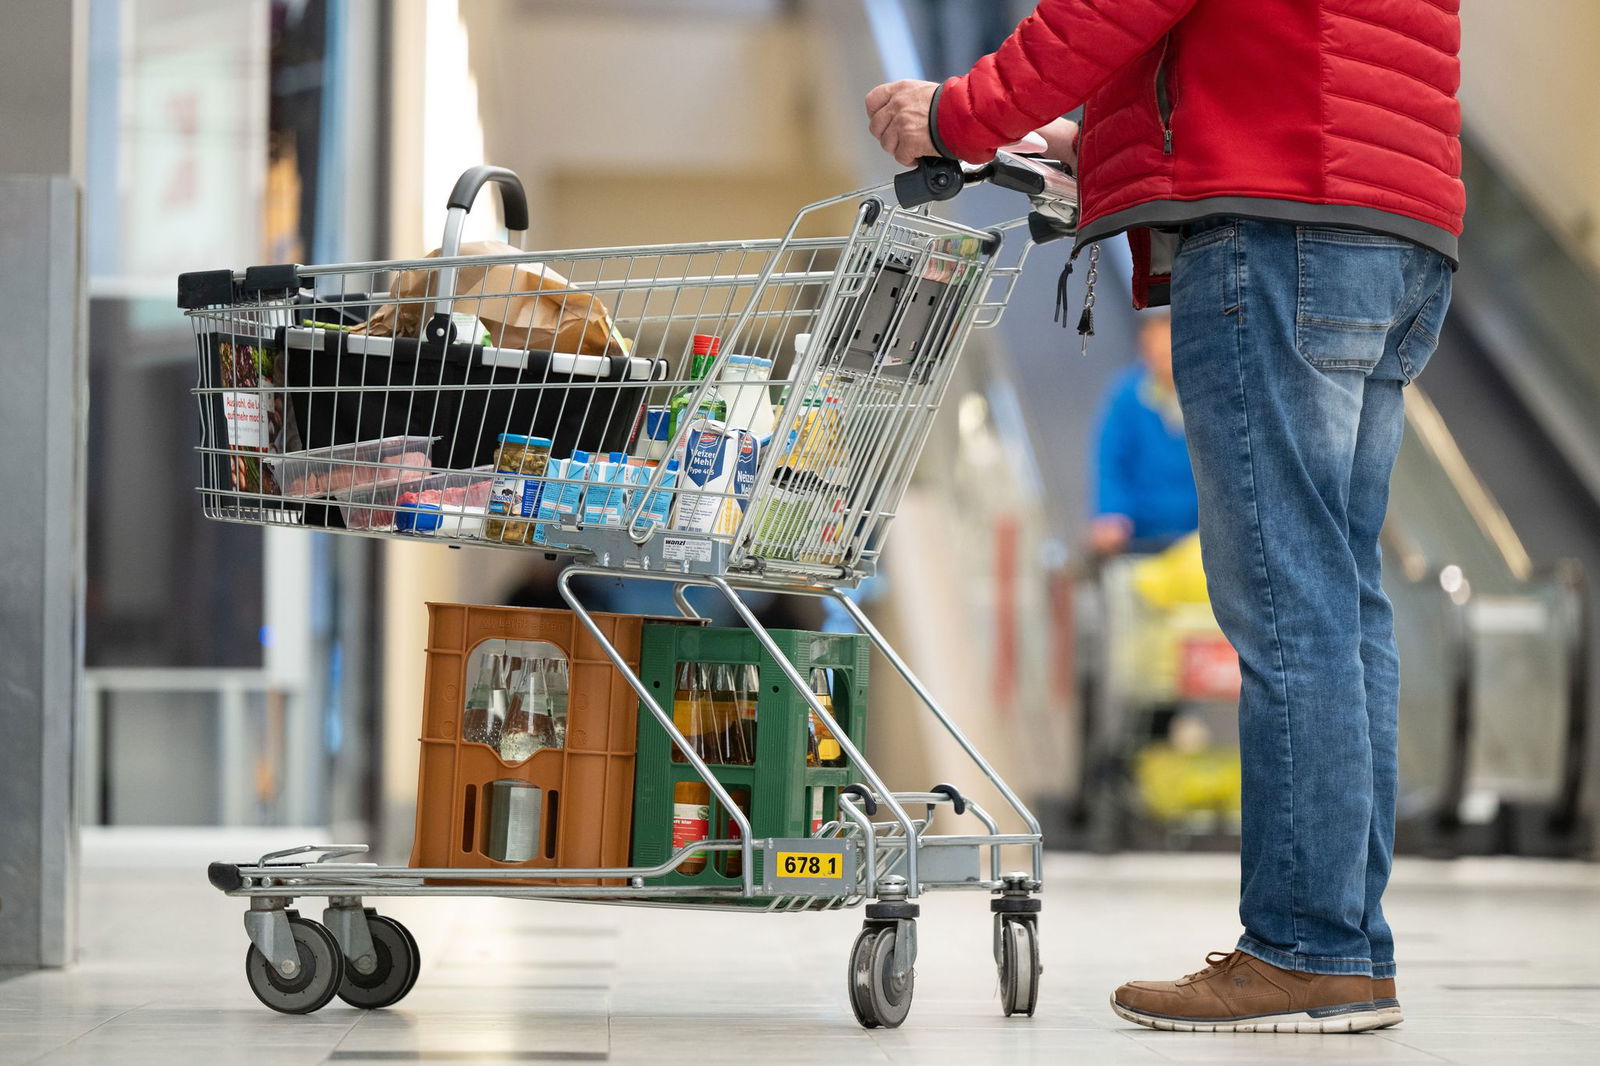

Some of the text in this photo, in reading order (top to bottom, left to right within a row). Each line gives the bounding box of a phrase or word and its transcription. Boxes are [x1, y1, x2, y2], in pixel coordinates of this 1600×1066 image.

[693, 457, 712, 466] Mehl
[784, 856, 836, 874] 678 1
